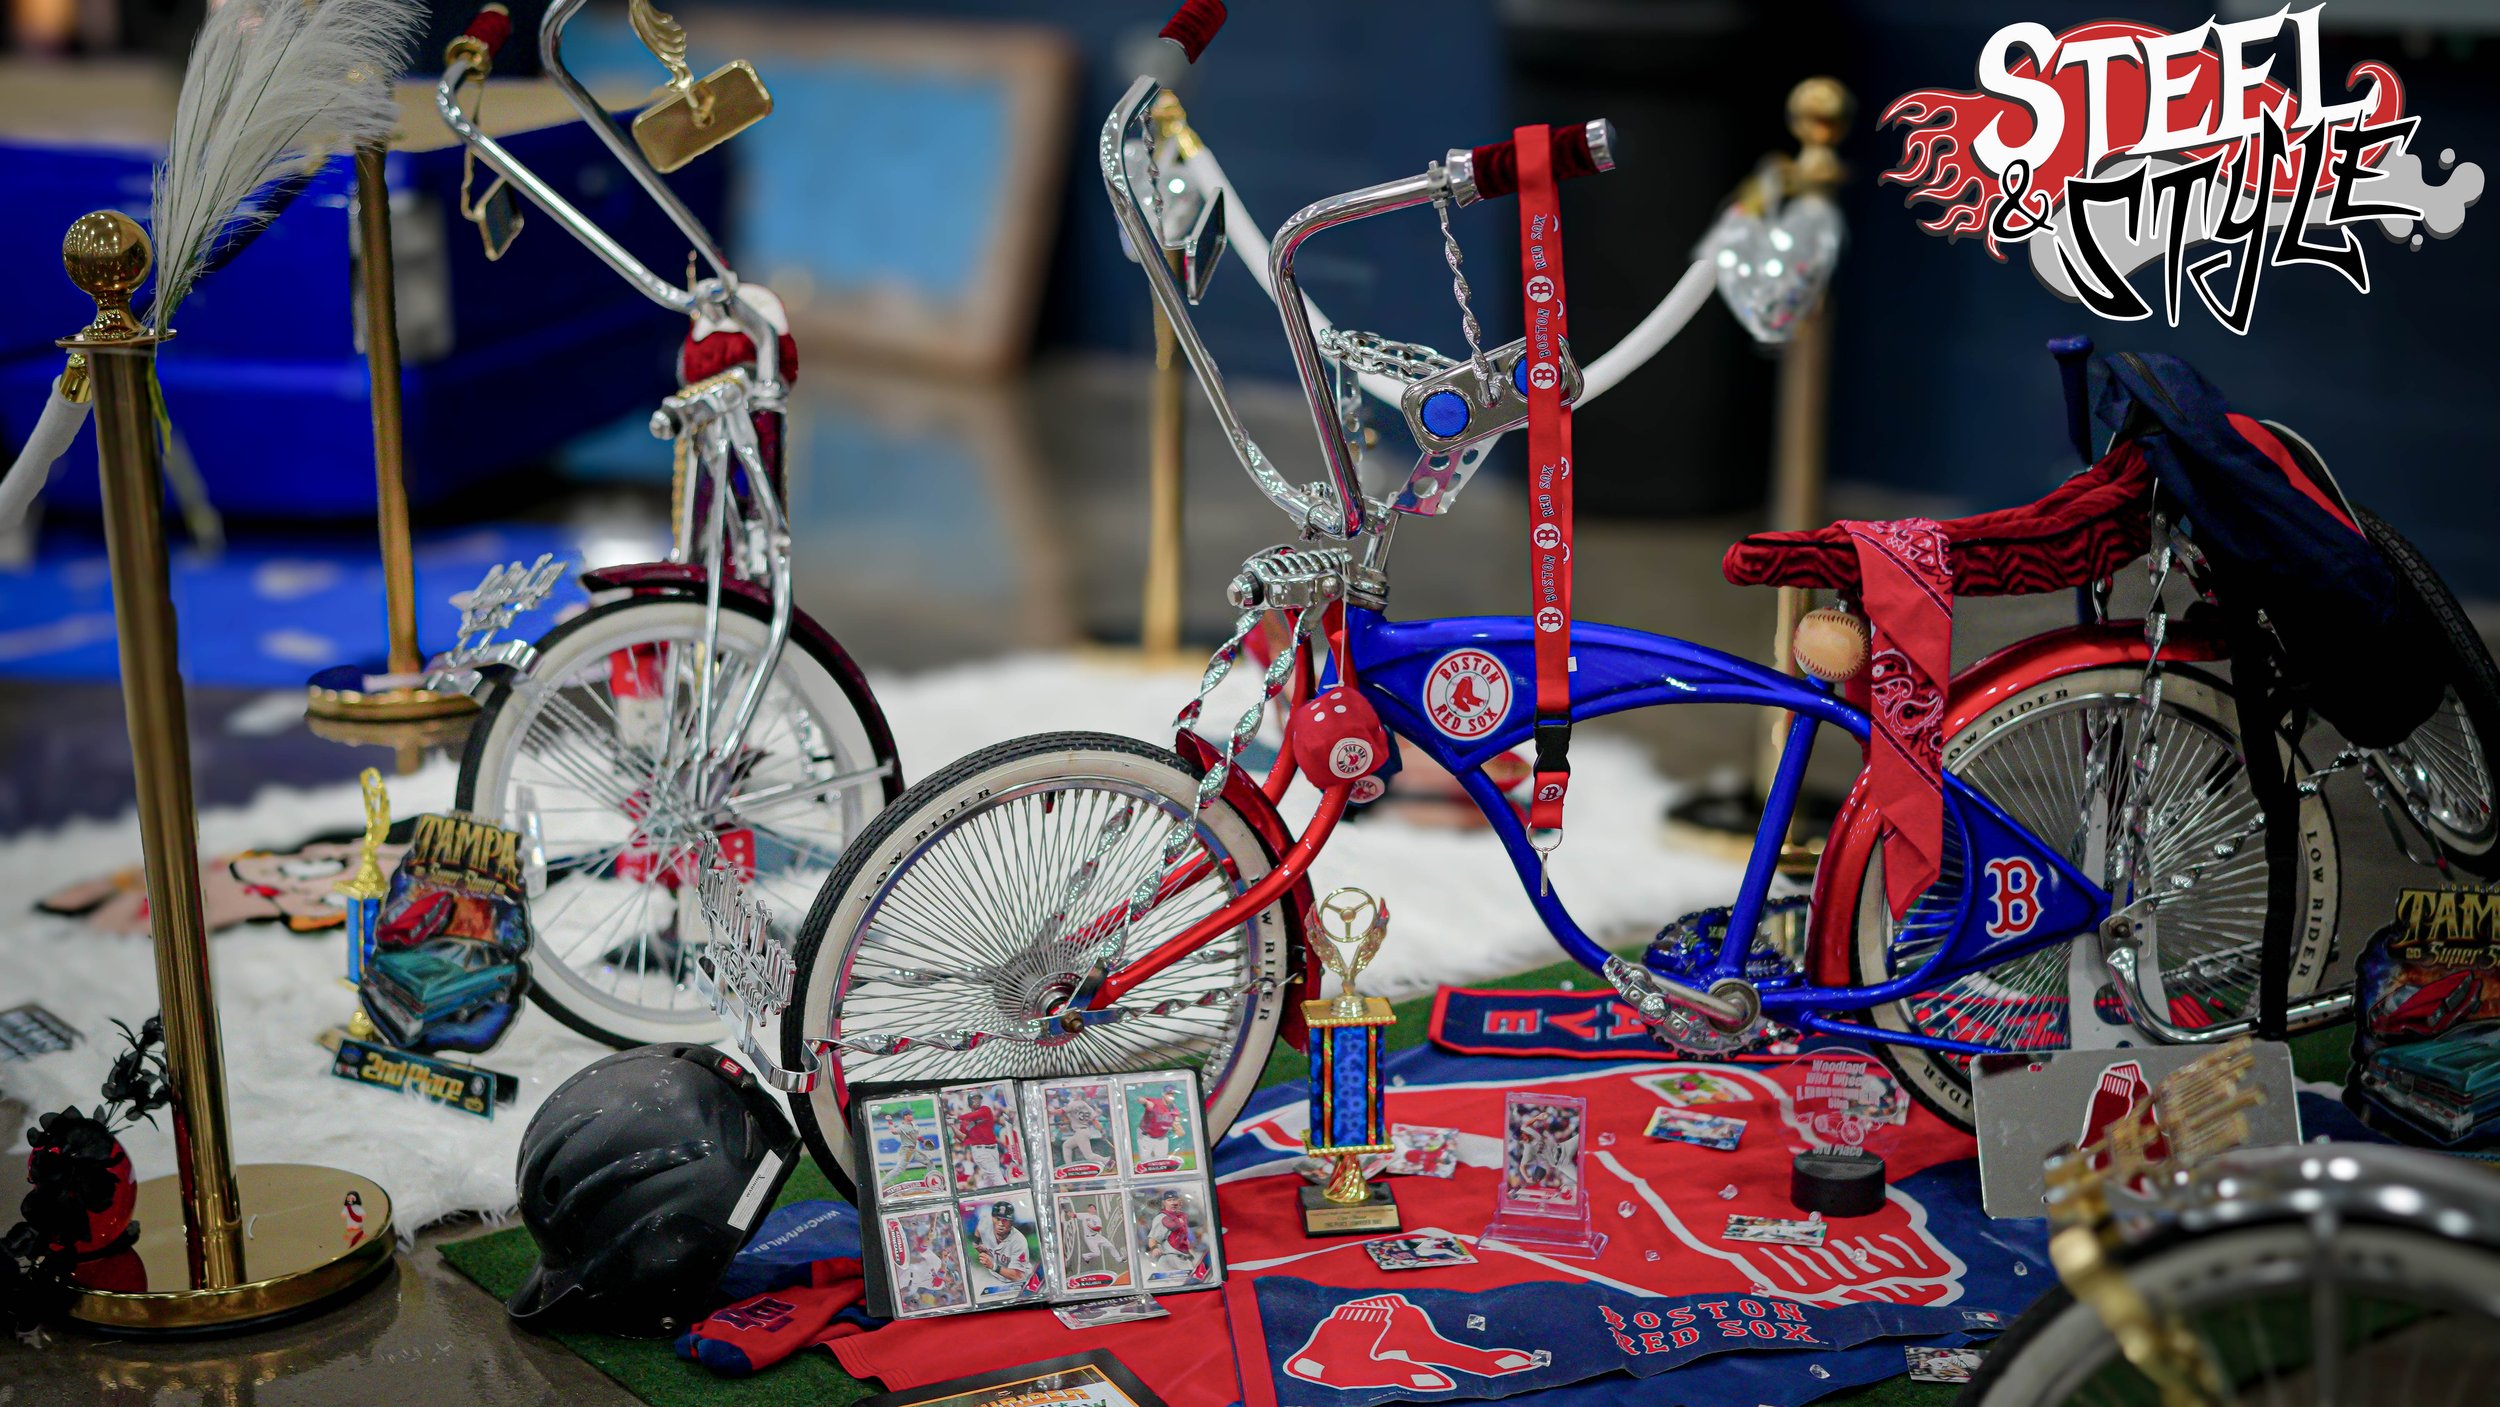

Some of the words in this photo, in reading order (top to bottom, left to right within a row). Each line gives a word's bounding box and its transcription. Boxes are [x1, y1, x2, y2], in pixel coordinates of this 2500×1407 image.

[1531, 214, 1548, 240] SOX
[1531, 246, 1548, 271] RED
[1536, 308, 1551, 358] BOSTON
[1539, 464, 1556, 490] SOX
[1539, 494, 1554, 518] RED
[1542, 554, 1558, 604] BOSTON
[1439, 657, 1501, 685] BOSTON
[1434, 704, 1460, 730] RED
[1469, 707, 1498, 732] SOX
[1948, 731, 1977, 760] OW
[1543, 785, 1559, 799] B
[409, 815, 522, 892] TAMPA
[861, 852, 902, 901] LOW
[915, 788, 991, 842] RIDER
[2306, 830, 2324, 884] LOW
[1251, 878, 1272, 925] LW
[1984, 856, 2044, 938] B
[2298, 898, 2324, 977] RIDER
[360, 1052, 408, 1086] 2nd
[406, 1063, 464, 1102] Place
[1806, 1072, 1830, 1085] Wild
[1812, 1059, 1867, 1074] Woodland
[1923, 1064, 1970, 1110] IDER
[1833, 1144, 1863, 1157] Place
[1598, 1299, 1807, 1330] BOSTON
[1608, 1327, 1700, 1356] RED
[1717, 1320, 1820, 1344] SOX
